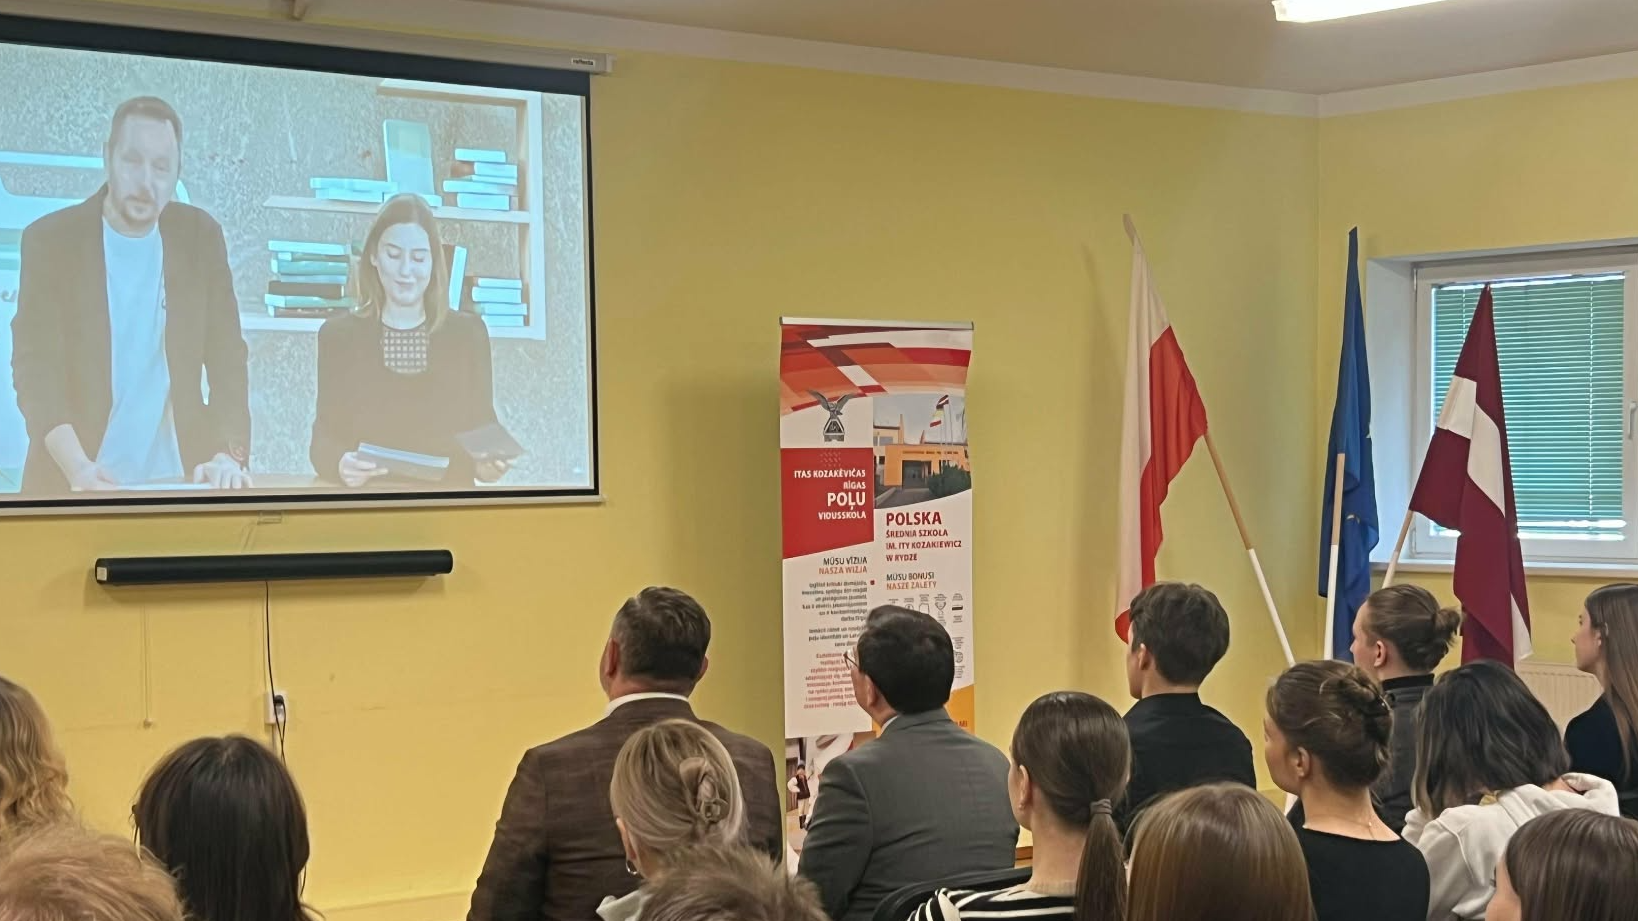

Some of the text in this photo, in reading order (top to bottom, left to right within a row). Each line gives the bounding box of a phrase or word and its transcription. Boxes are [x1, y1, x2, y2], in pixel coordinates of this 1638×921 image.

[794, 470, 811, 478] ITAS
[827, 491, 866, 511] POĻU
[886, 511, 942, 526] POLSKA
[898, 542, 910, 550] ITY
[911, 540, 962, 549] KOZAKIEWICZ
[894, 553, 918, 561] RYDZE
[819, 565, 868, 574] NASZA WIZJA
[886, 582, 909, 590] NASZE
